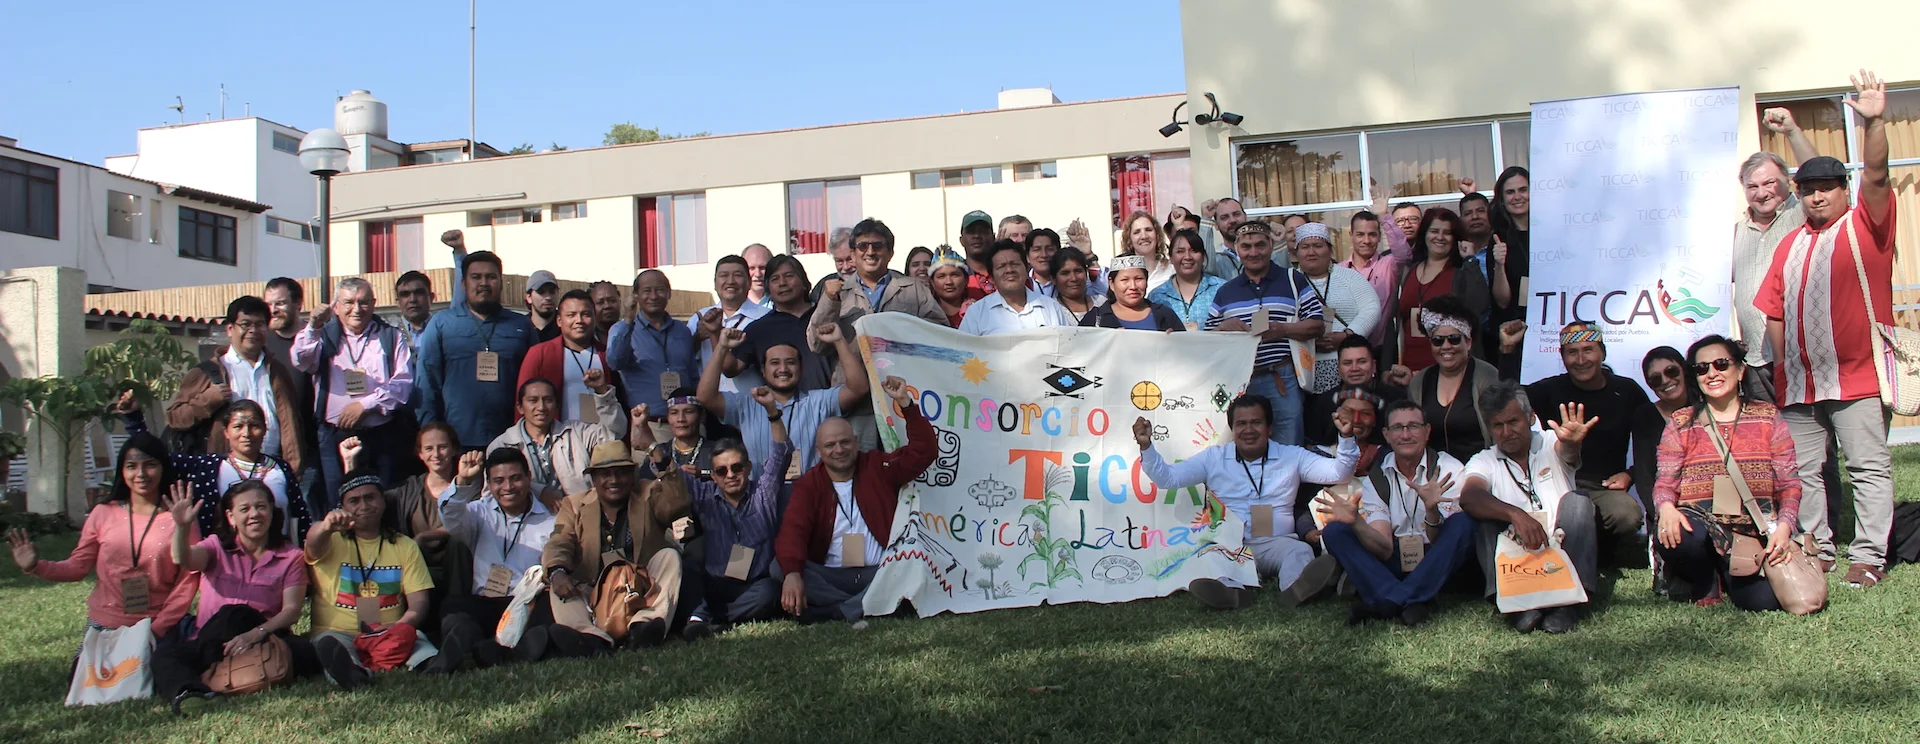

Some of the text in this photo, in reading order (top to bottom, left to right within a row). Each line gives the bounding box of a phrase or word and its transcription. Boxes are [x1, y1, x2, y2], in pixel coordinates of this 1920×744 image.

[1532, 107, 1566, 120] ICCA
[1602, 100, 1642, 114] TICCA
[1563, 139, 1603, 154] TICCA
[1600, 174, 1640, 186] TICCA
[1563, 212, 1600, 225] TICCA
[1636, 209, 1678, 222] TICCA
[1596, 247, 1636, 260] TICCA
[1535, 290, 1659, 326] TICCA
[1070, 508, 1199, 550] Latina
[1500, 563, 1547, 577] TICCA
